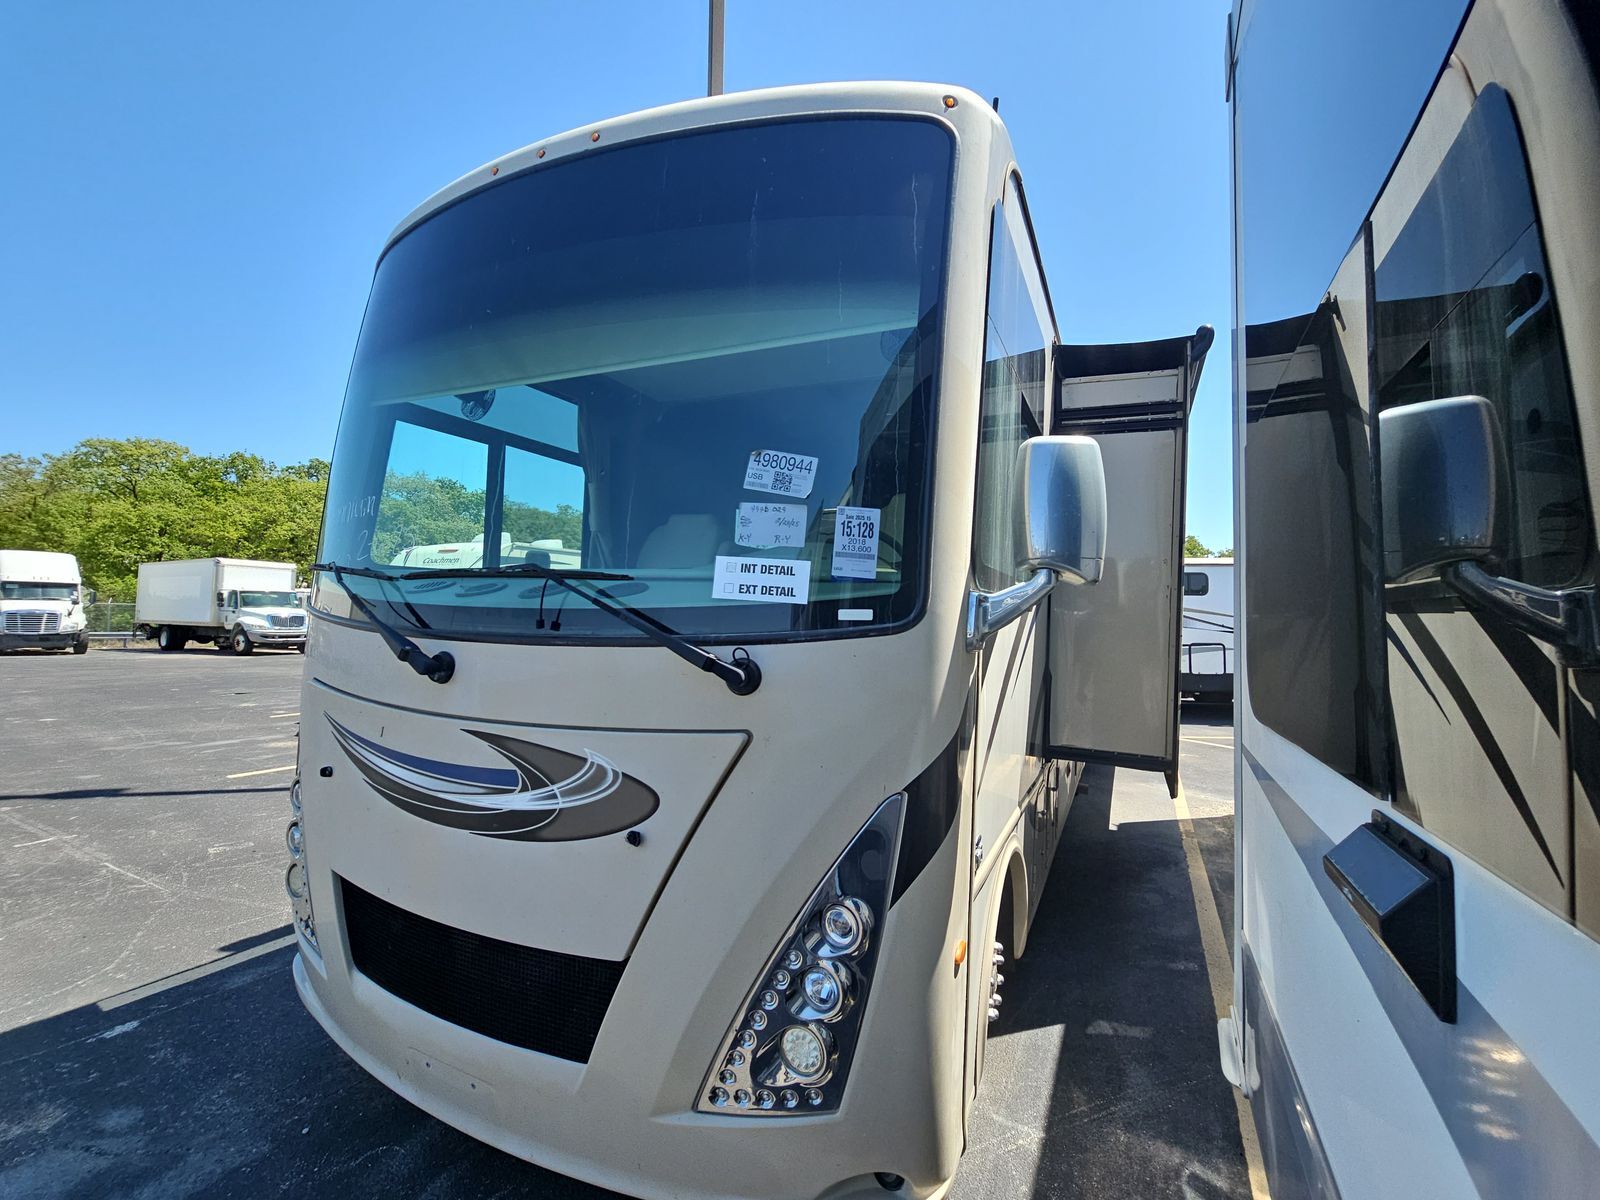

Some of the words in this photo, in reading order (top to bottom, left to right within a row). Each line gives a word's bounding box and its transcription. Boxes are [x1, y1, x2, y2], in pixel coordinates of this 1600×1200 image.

[753, 451, 813, 474] 4980944
[747, 472, 764, 480] USB
[840, 520, 875, 539] 15:128
[847, 537, 867, 545] 2018
[841, 544, 872, 553] X13,600
[422, 556, 460, 565] Coachmen
[740, 562, 757, 574] INT
[760, 563, 796, 576] DETAIL
[738, 583, 758, 595] EXT
[760, 585, 797, 598] DETAIL
